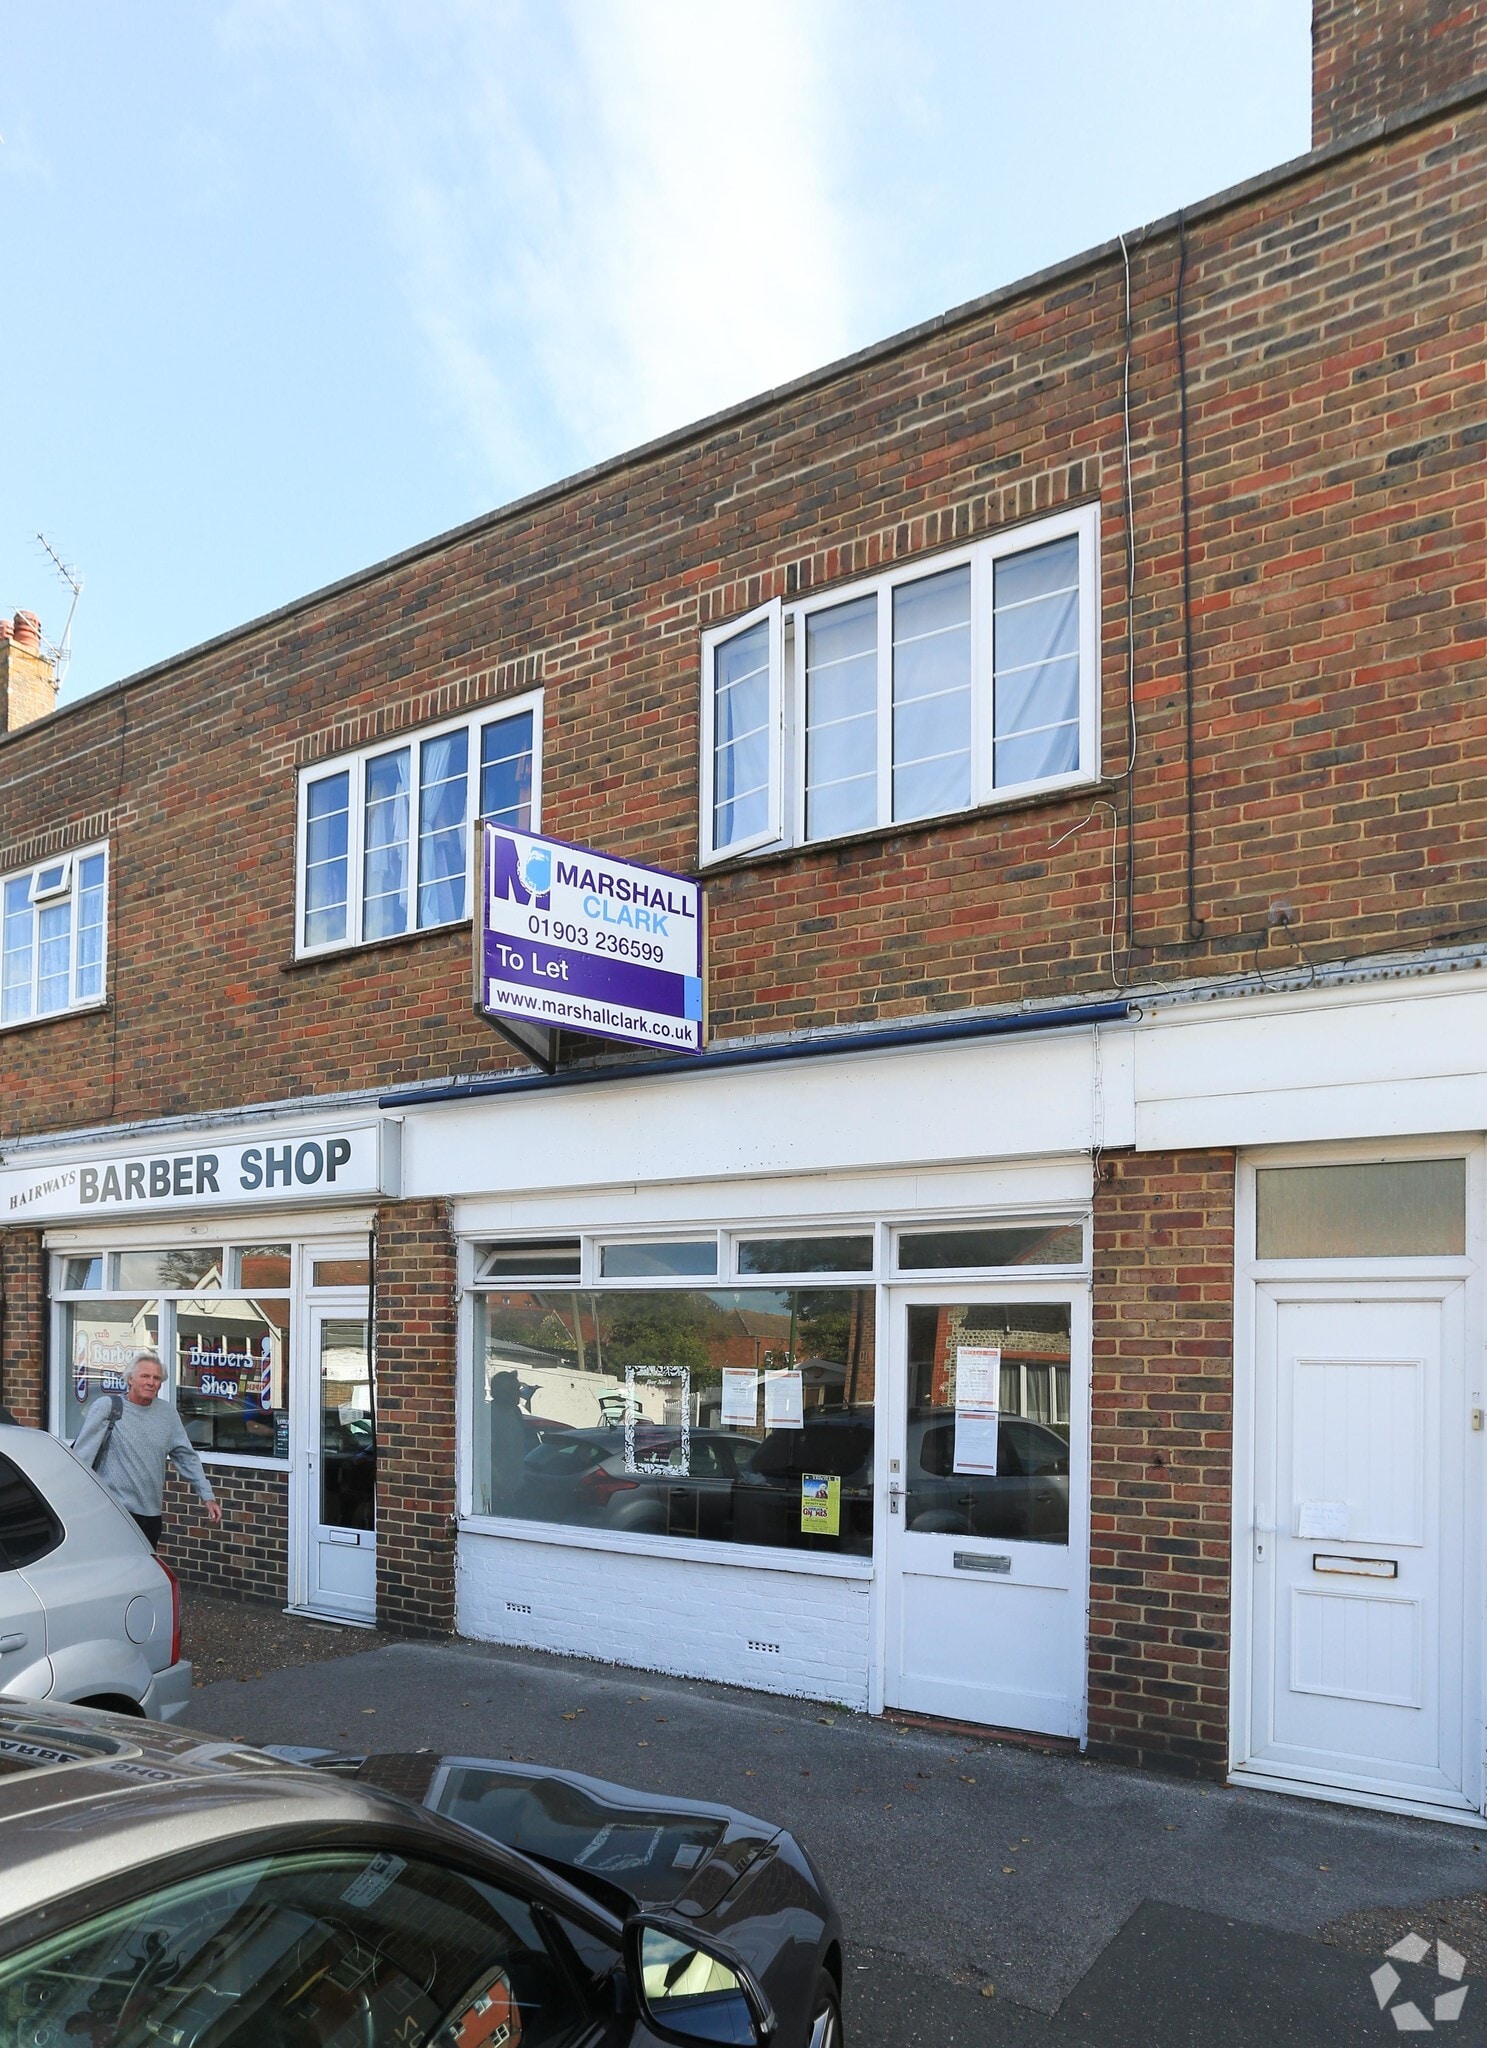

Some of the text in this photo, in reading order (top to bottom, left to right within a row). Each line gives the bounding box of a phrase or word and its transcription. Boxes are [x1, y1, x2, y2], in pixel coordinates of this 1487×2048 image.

[557, 861, 695, 918] MARSHALL
[583, 894, 669, 937] CLARK
[528, 915, 664, 963] 01903 236599
[496, 943, 569, 980] To Let
[497, 989, 692, 1041] www.marshallclark.co.uk
[10, 1170, 76, 1209] HAIRWAYS
[79, 1138, 351, 1204] BARBER SHOP
[92, 1342, 141, 1364] Barbe
[190, 1346, 253, 1368] Barbers
[102, 1371, 129, 1390] Sho
[201, 1375, 238, 1400] Shop
